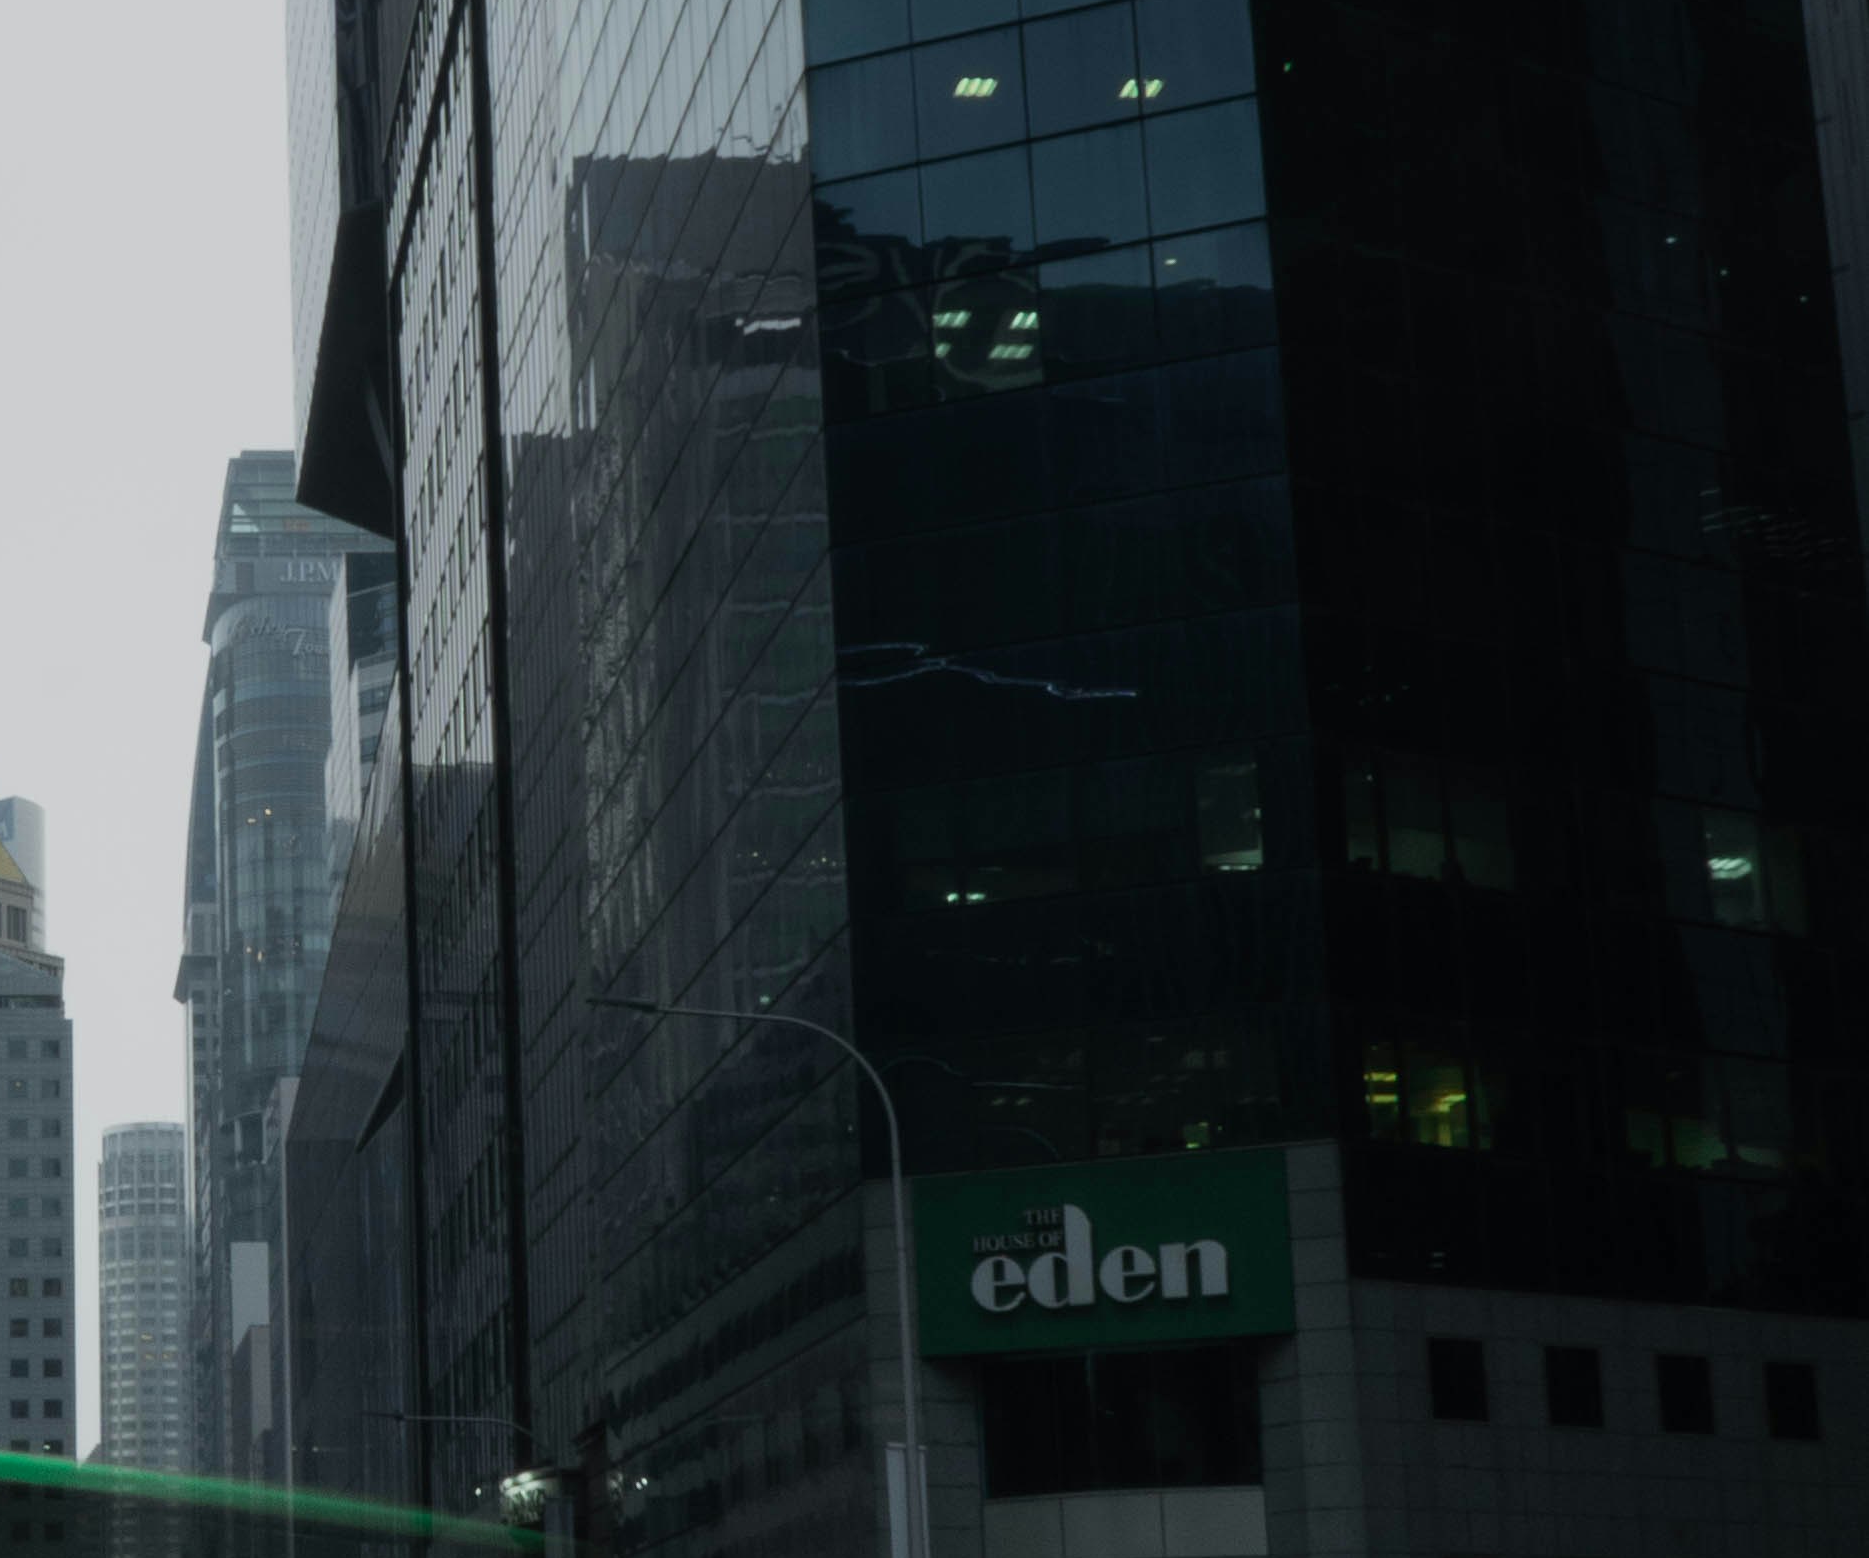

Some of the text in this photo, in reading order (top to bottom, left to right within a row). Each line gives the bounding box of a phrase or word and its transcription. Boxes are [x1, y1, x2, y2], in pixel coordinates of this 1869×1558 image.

[1024, 1208, 1063, 1227] THE
[973, 1230, 1063, 1254] HOUSE OF
[971, 1203, 1228, 1312] eden
